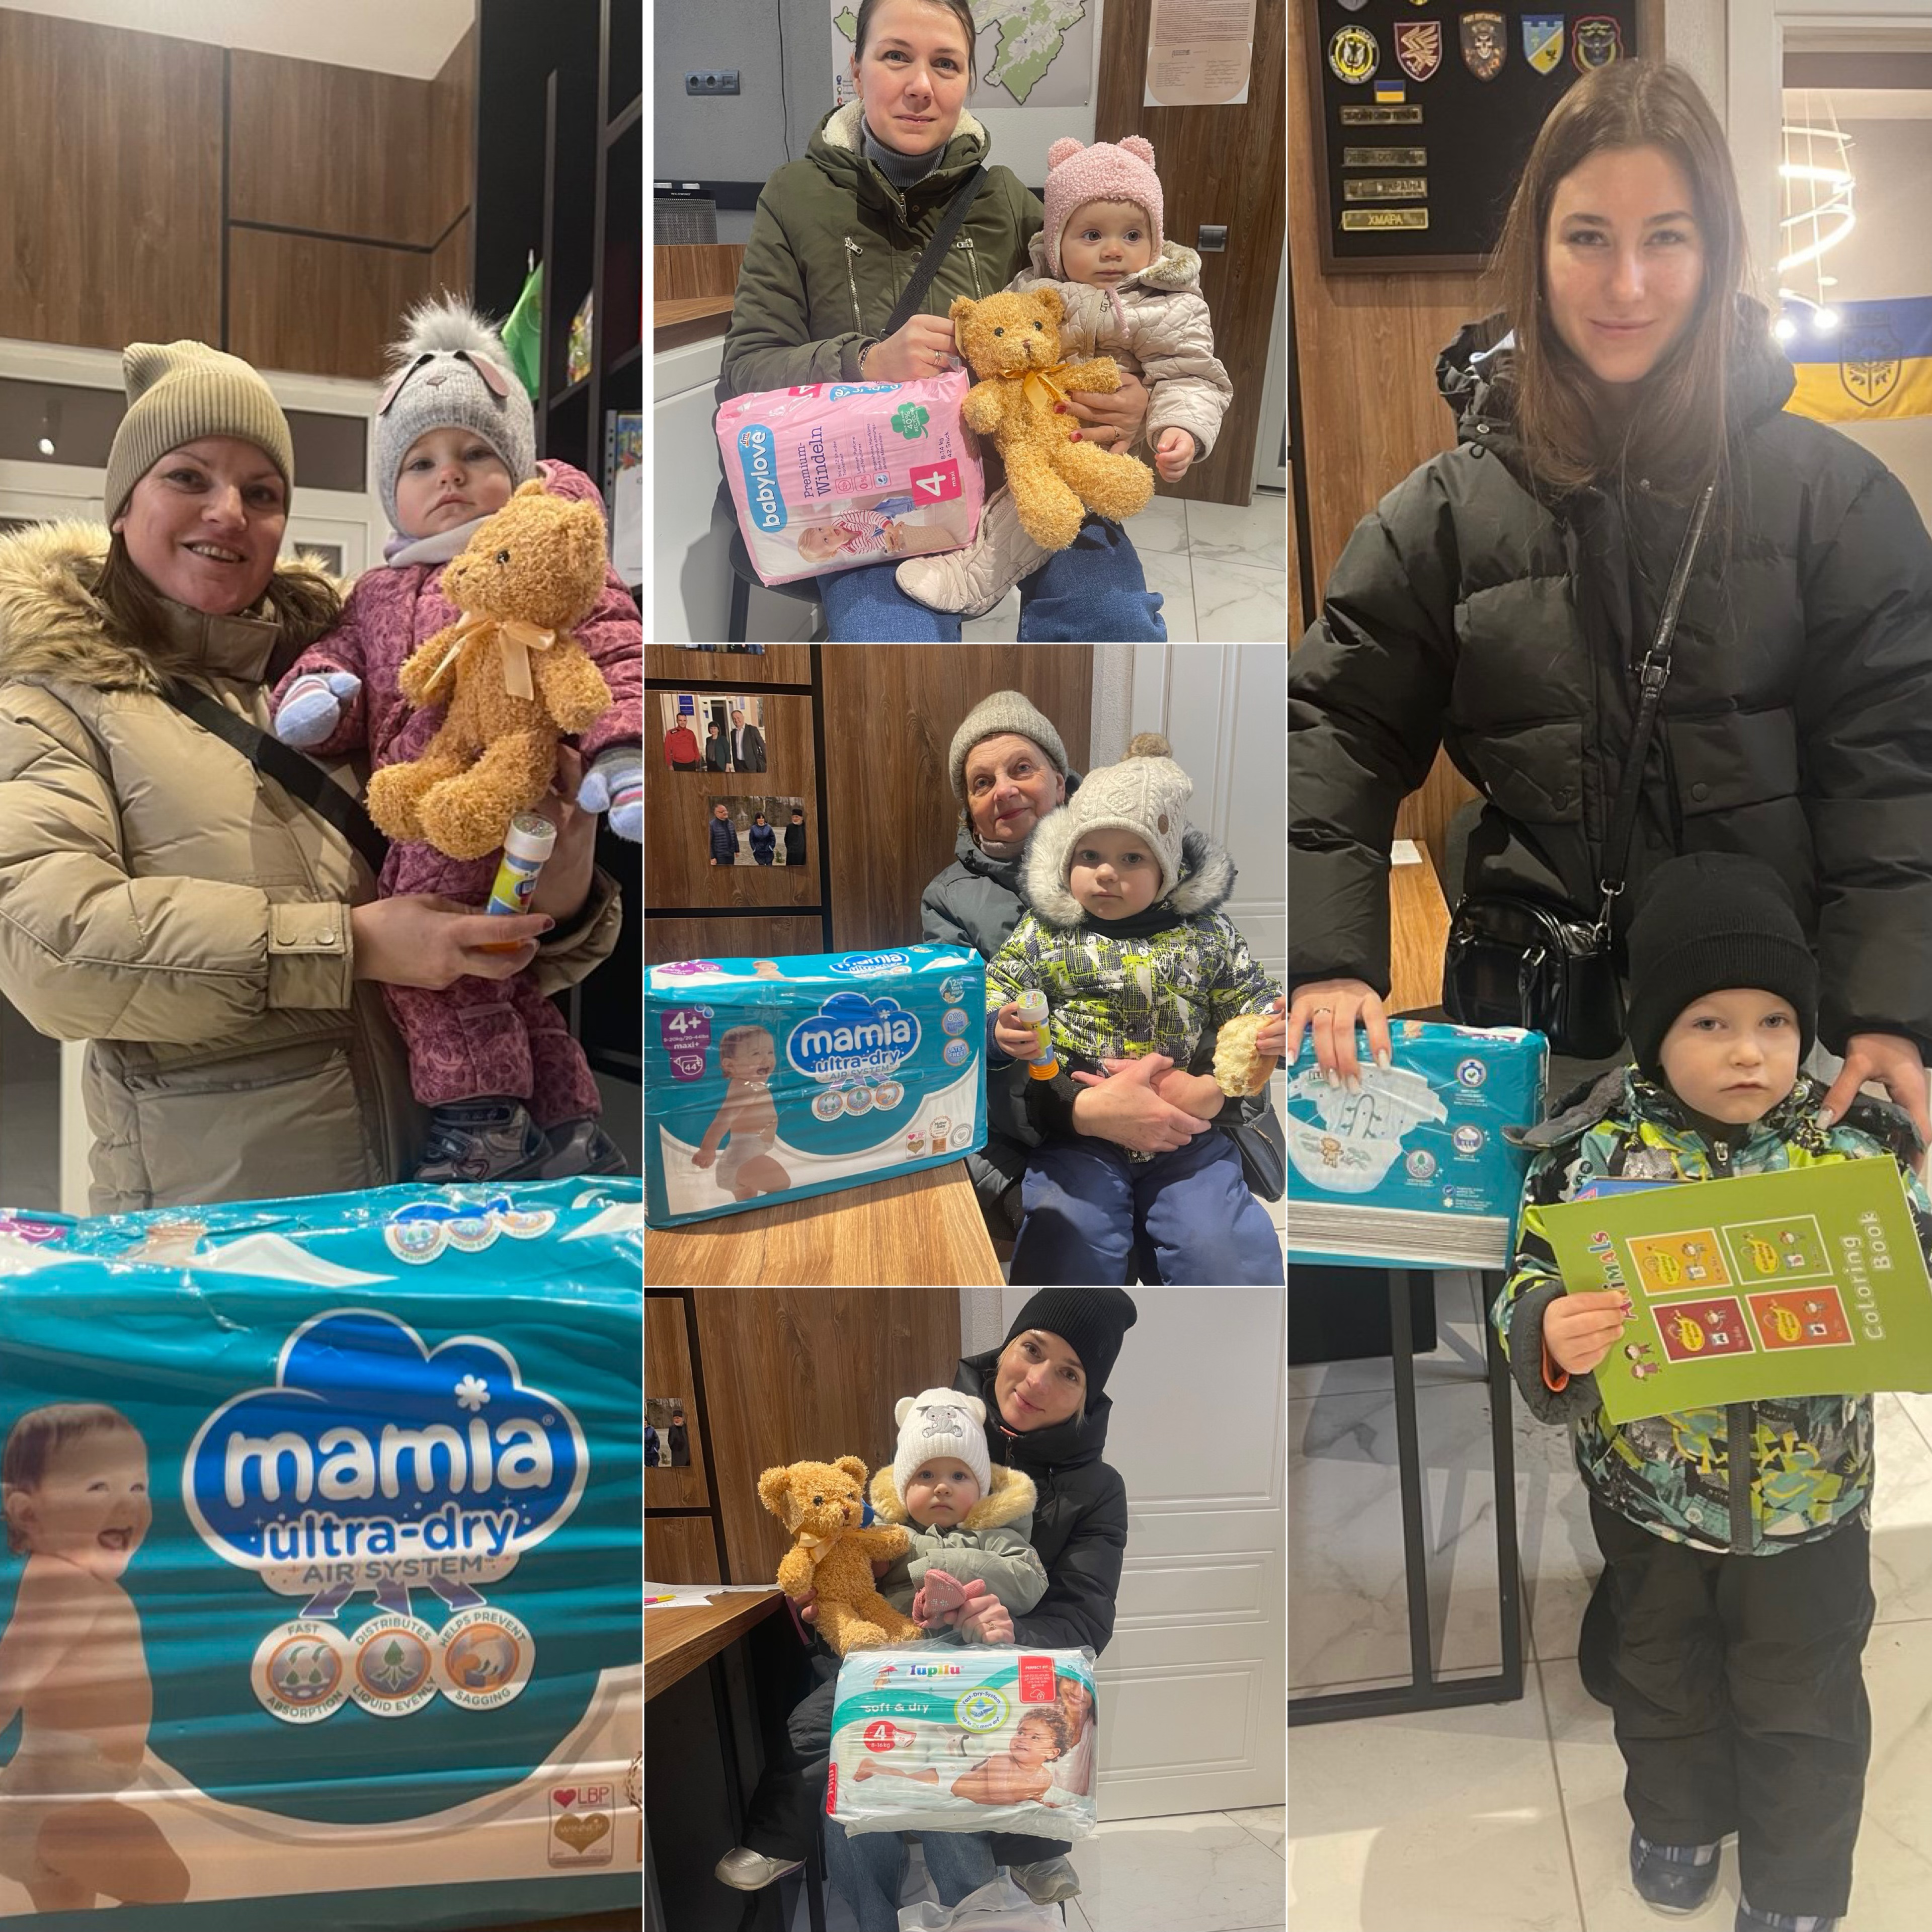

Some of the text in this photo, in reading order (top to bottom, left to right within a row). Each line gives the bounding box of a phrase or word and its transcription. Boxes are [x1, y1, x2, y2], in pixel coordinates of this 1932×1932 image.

[1367, 214, 1403, 225] ХМАРА
[904, 411, 913, 429] 40%
[740, 433, 748, 445] dm
[809, 426, 831, 497] Windeln
[869, 446, 877, 471] angenehmes
[947, 449, 952, 457] 42
[751, 431, 781, 527] babylove
[797, 442, 815, 498] Premium-
[916, 471, 946, 497] 4
[668, 1012, 701, 1034] 4+
[947, 1012, 962, 1022] 0%
[674, 1041, 700, 1050] maxi+
[947, 1044, 965, 1053] LATEX
[818, 1049, 900, 1073] ultra-dry
[830, 1072, 848, 1080] AIR
[1860, 1212, 1891, 1268] Book
[1843, 1237, 1883, 1338] Coloring
[268, 1507, 515, 1559] ultra-dry
[302, 1563, 354, 1584] AIR
[288, 1624, 319, 1635] FAST
[355, 1617, 432, 1645] DISTRIBUTES
[440, 1613, 526, 1647] HELPS PREVENT
[910, 1664, 960, 1677] lupilu
[353, 1677, 438, 1711] LIQUID EVENLY
[455, 1688, 511, 1706] SAGGING
[962, 1692, 1001, 1705] Fast-Dry-System
[267, 1691, 343, 1719] ABSORPTION
[865, 1703, 890, 1713] soft
[909, 1703, 929, 1713] dry
[873, 1725, 887, 1740] 4
[578, 1787, 610, 1804] LBP
